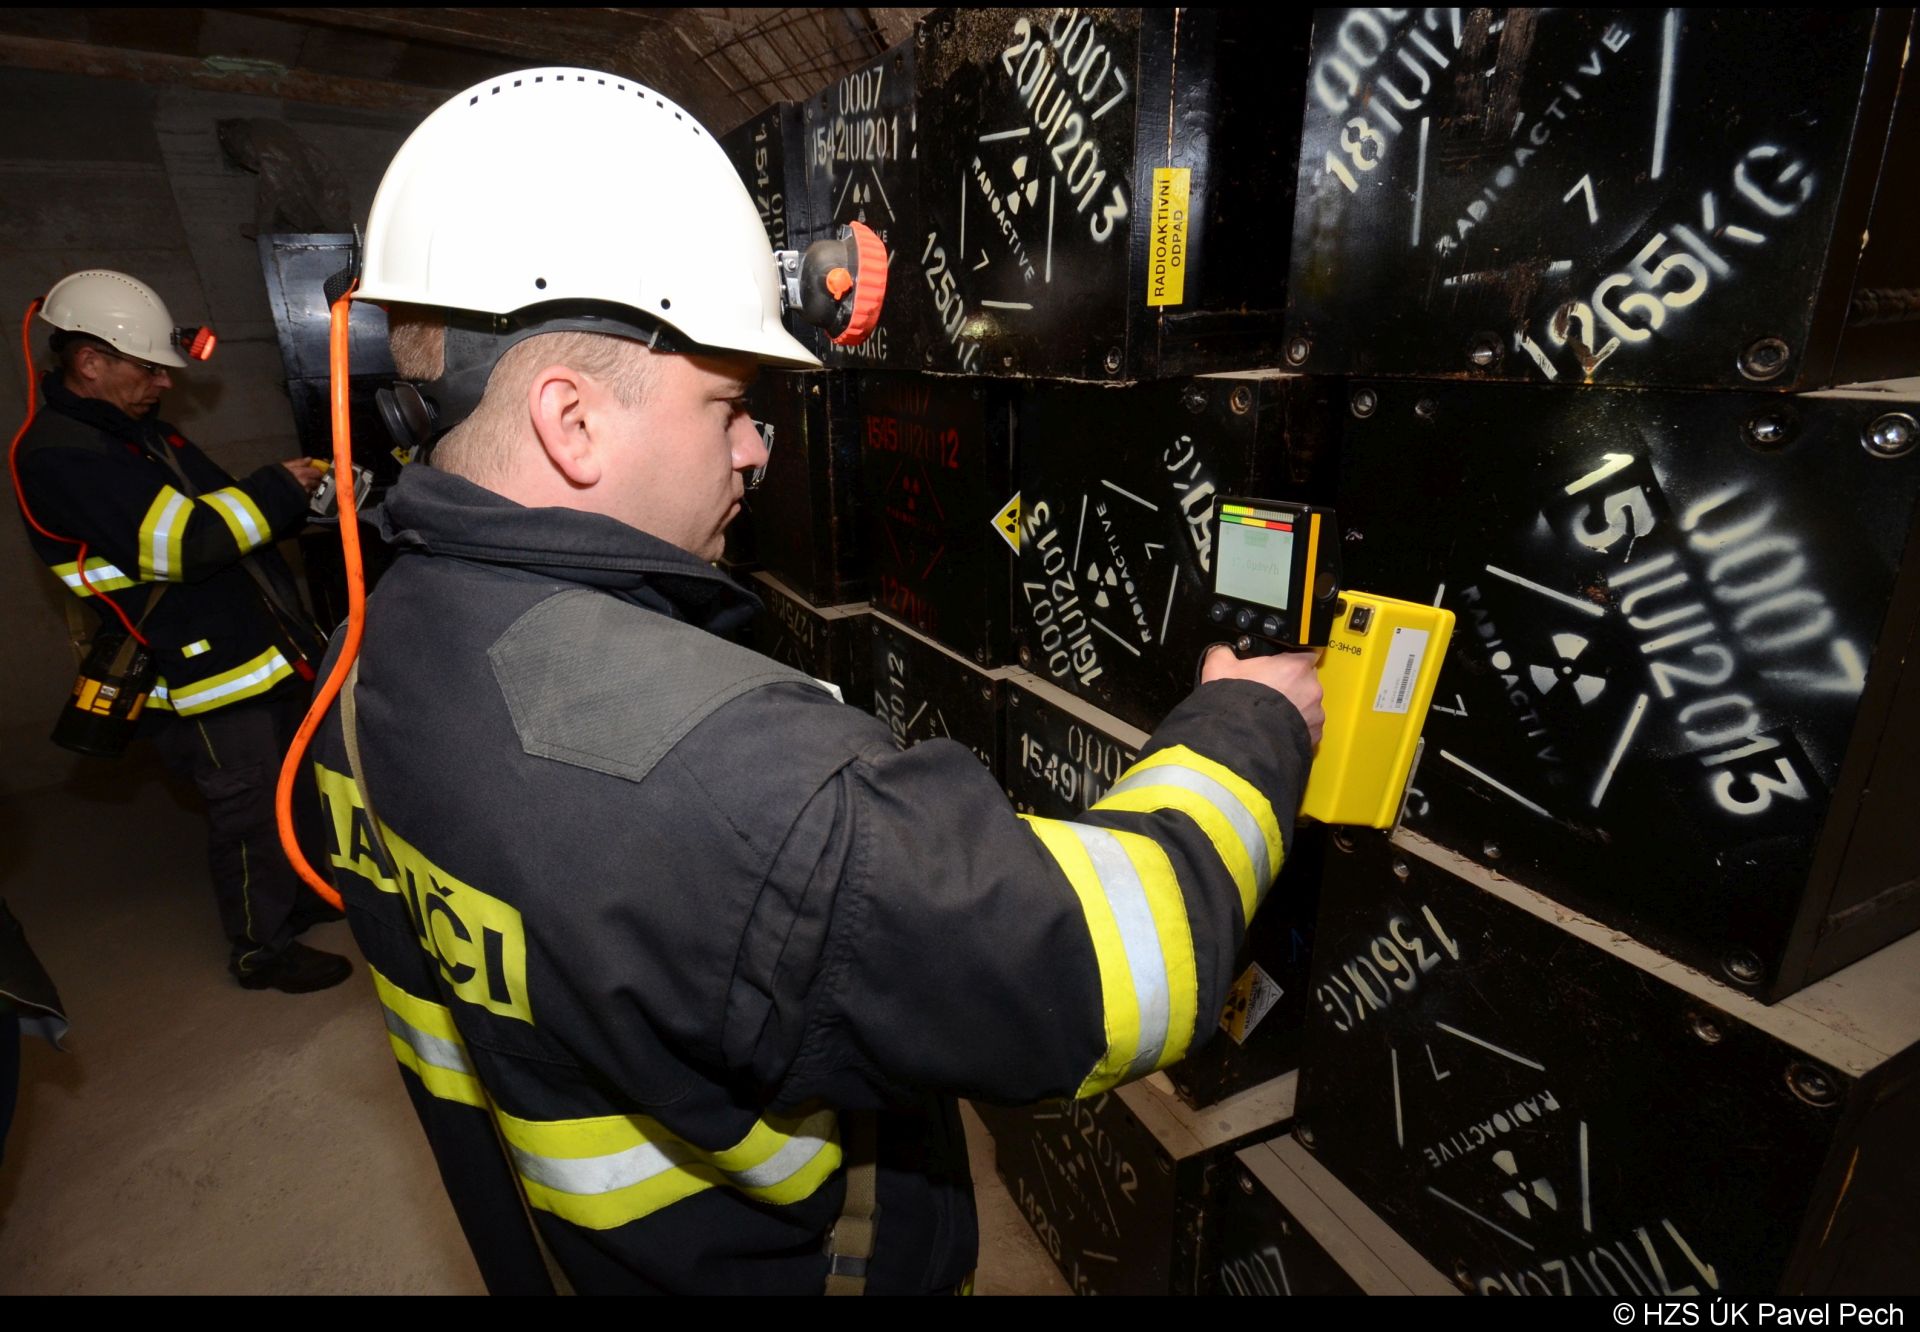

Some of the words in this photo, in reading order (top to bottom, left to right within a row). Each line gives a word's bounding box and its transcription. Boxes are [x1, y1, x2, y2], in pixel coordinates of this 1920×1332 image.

[839, 65, 884, 116] 0007
[1434, 22, 1632, 257] RADIOACTIVE
[971, 156, 1035, 283] RADIOACTIVE
[1153, 179, 1171, 298] RADIOAKTIVNÍ
[1171, 208, 1184, 268] ODPAD
[1564, 173, 1599, 224] 7
[1095, 500, 1153, 643] RADIOACTIVE
[1023, 580, 1074, 678] 0007
[1423, 1089, 1561, 1169] RADIOACTIVE
